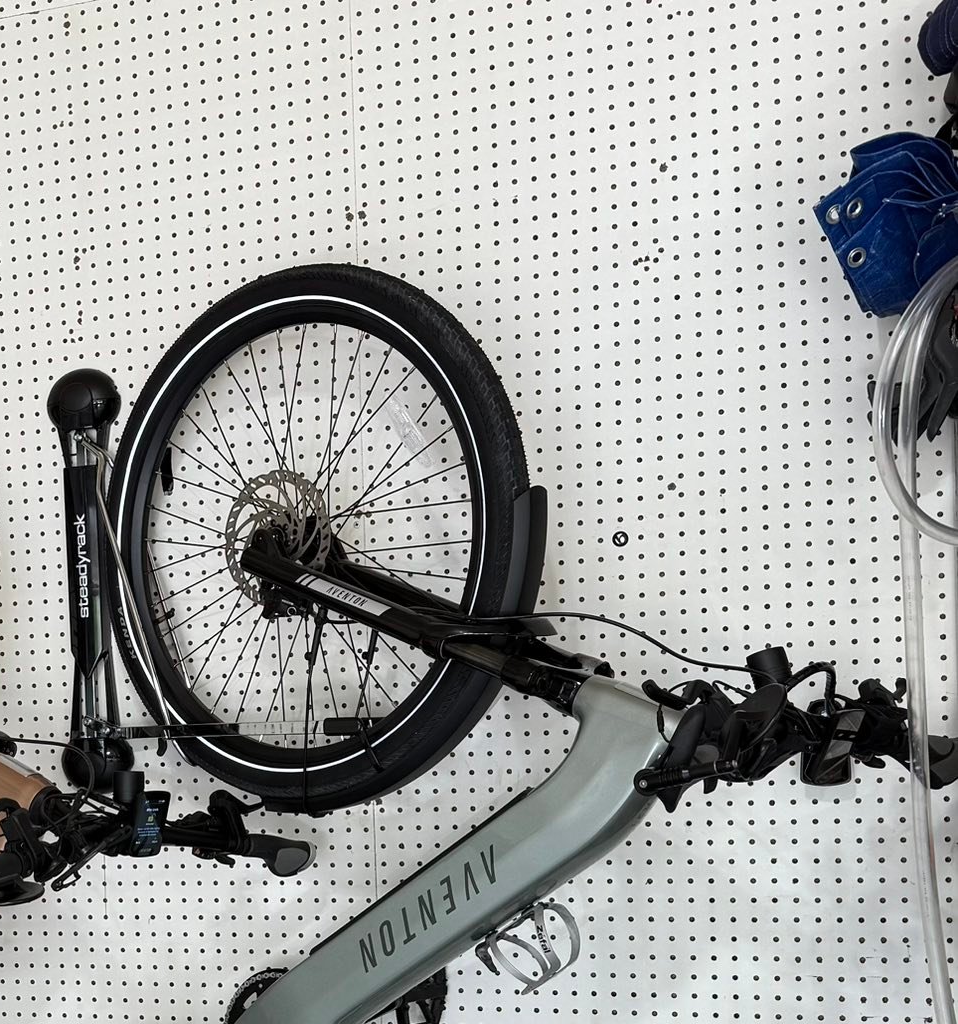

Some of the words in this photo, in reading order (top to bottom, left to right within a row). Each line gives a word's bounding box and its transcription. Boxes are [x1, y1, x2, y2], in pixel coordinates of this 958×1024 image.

[73, 513, 91, 618] steadyrack
[325, 586, 368, 607] AVENTON
[358, 844, 497, 973] AVENTON
